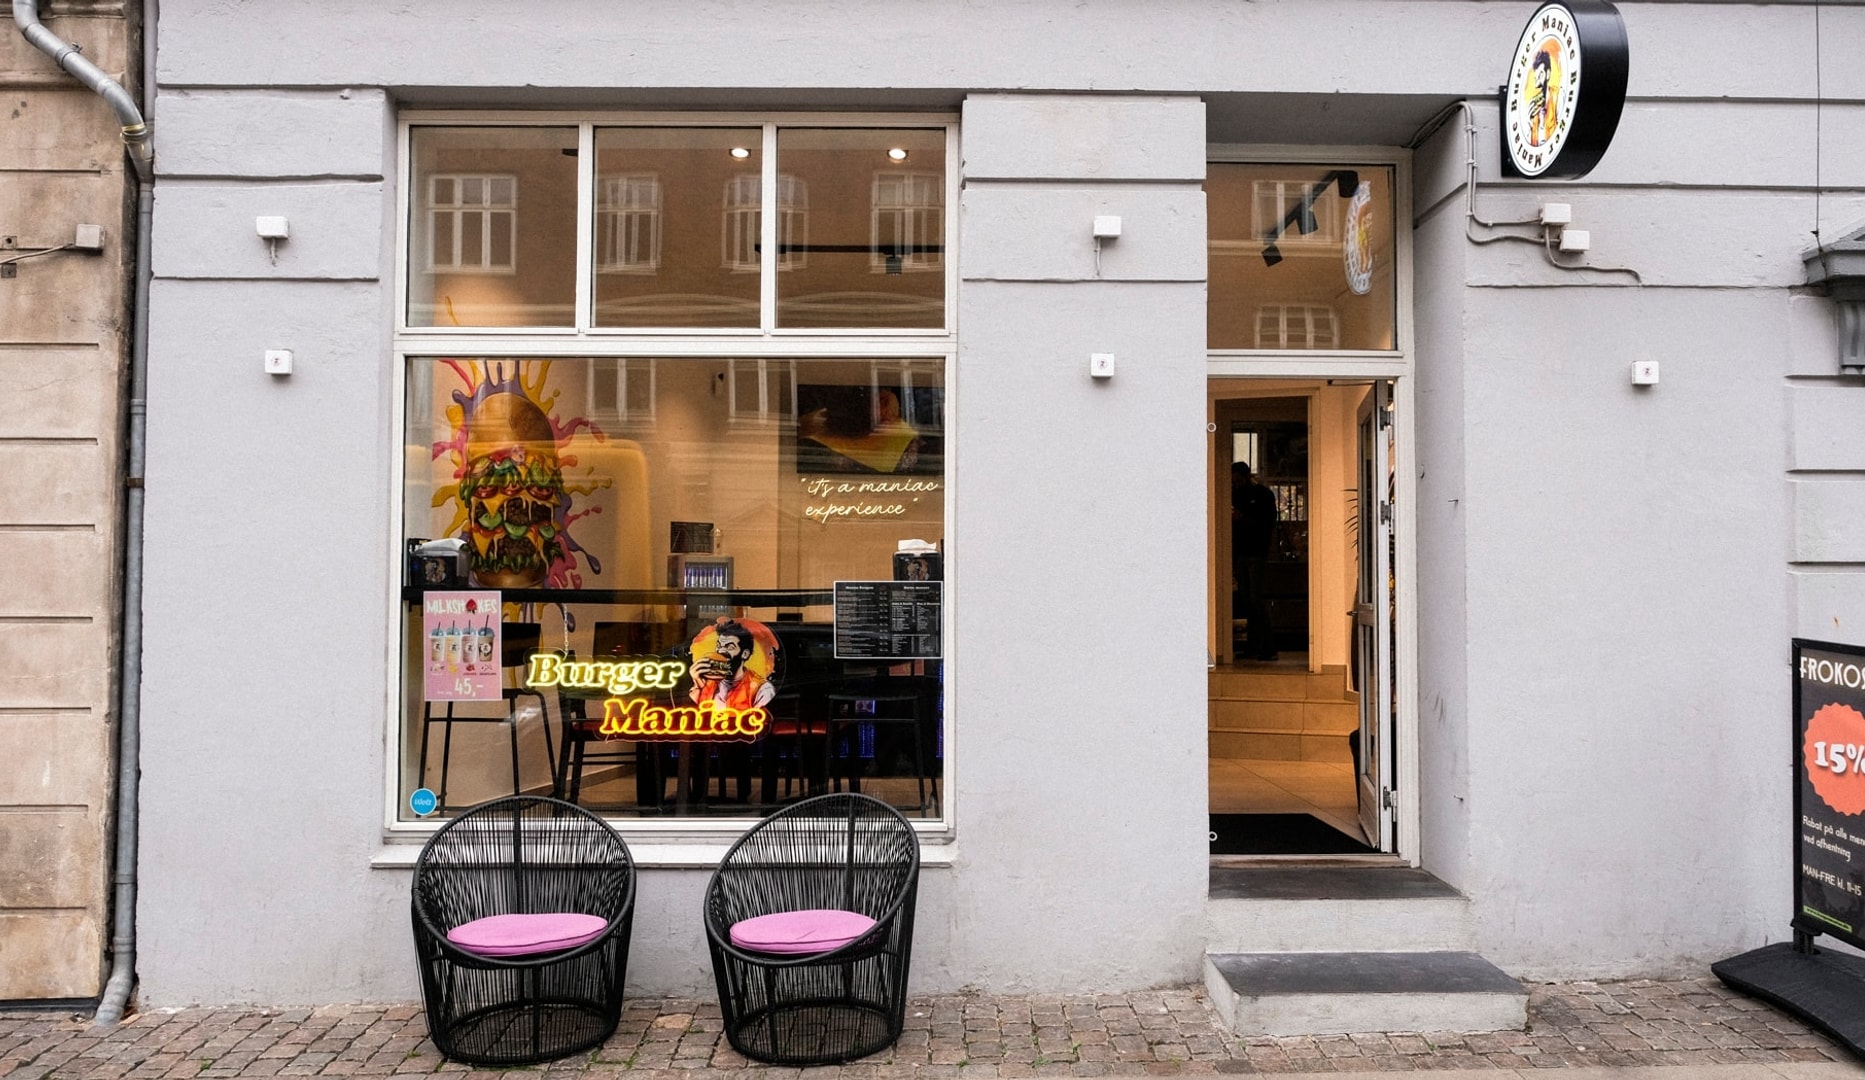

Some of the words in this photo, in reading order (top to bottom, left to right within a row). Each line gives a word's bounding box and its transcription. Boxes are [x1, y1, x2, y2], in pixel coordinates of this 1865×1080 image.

[1511, 32, 1536, 112] Burger
[1542, 15, 1576, 60] Maniac
[1513, 123, 1542, 168] Maniac
[837, 482, 855, 493] a
[858, 479, 938, 493] maniac
[426, 598, 498, 614] MILKSHKES
[526, 654, 686, 695] Burger
[600, 699, 766, 735] Maniac
[1814, 741, 1865, 774] 15%
[1802, 815, 1822, 831] Rabat
[1824, 825, 1834, 836] på
[1835, 827, 1847, 840] alle
[1803, 834, 1815, 845] ved
[1816, 838, 1851, 862] afhentning
[1802, 864, 1836, 886] MAN-FRE
